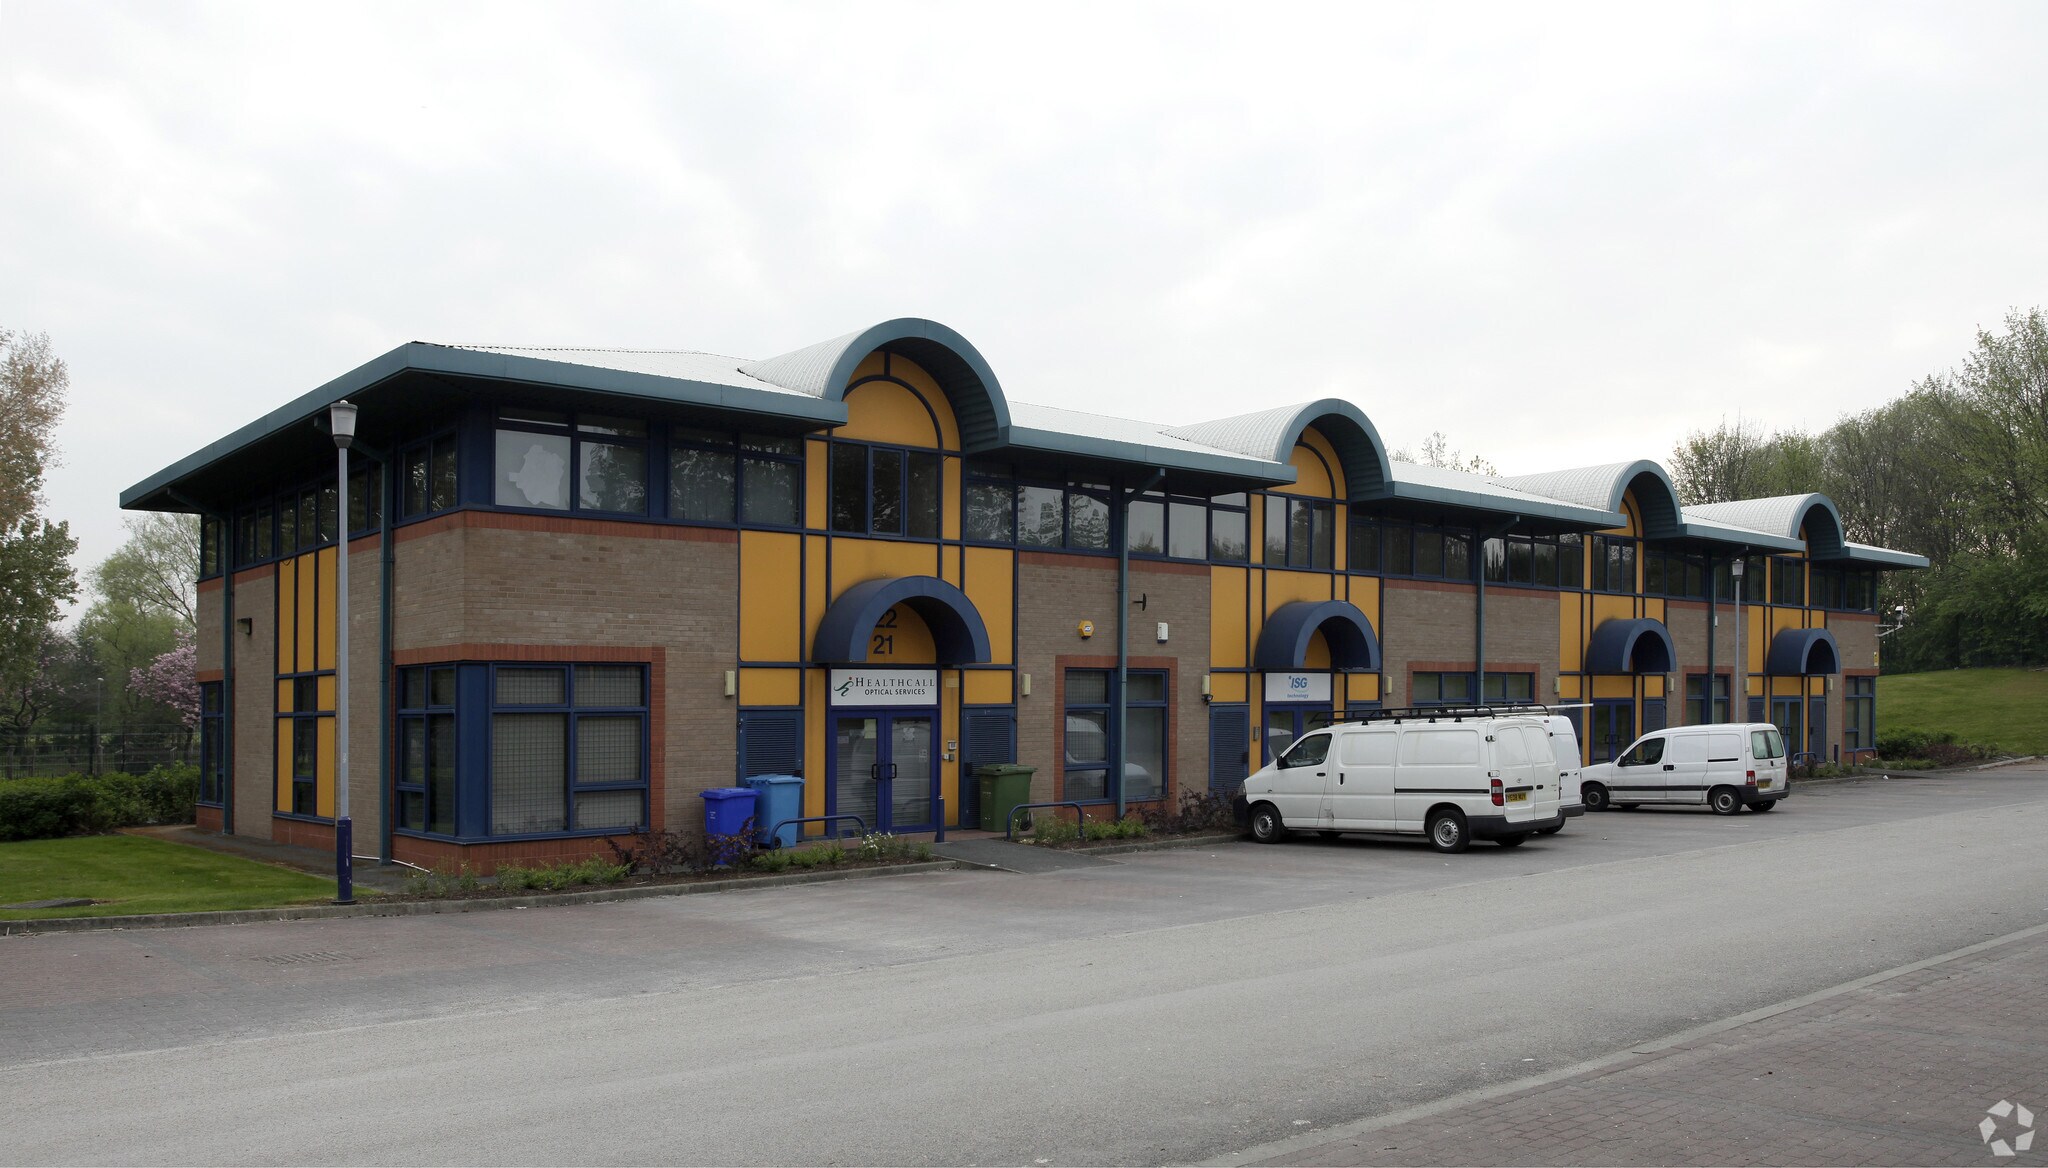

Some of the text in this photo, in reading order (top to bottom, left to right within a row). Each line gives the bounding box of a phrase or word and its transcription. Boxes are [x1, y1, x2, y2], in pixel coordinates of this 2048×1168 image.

[873, 634, 893, 655] 21
[1291, 677, 1308, 688] ISG
[864, 688, 926, 696] OPTICAL SERVICES
